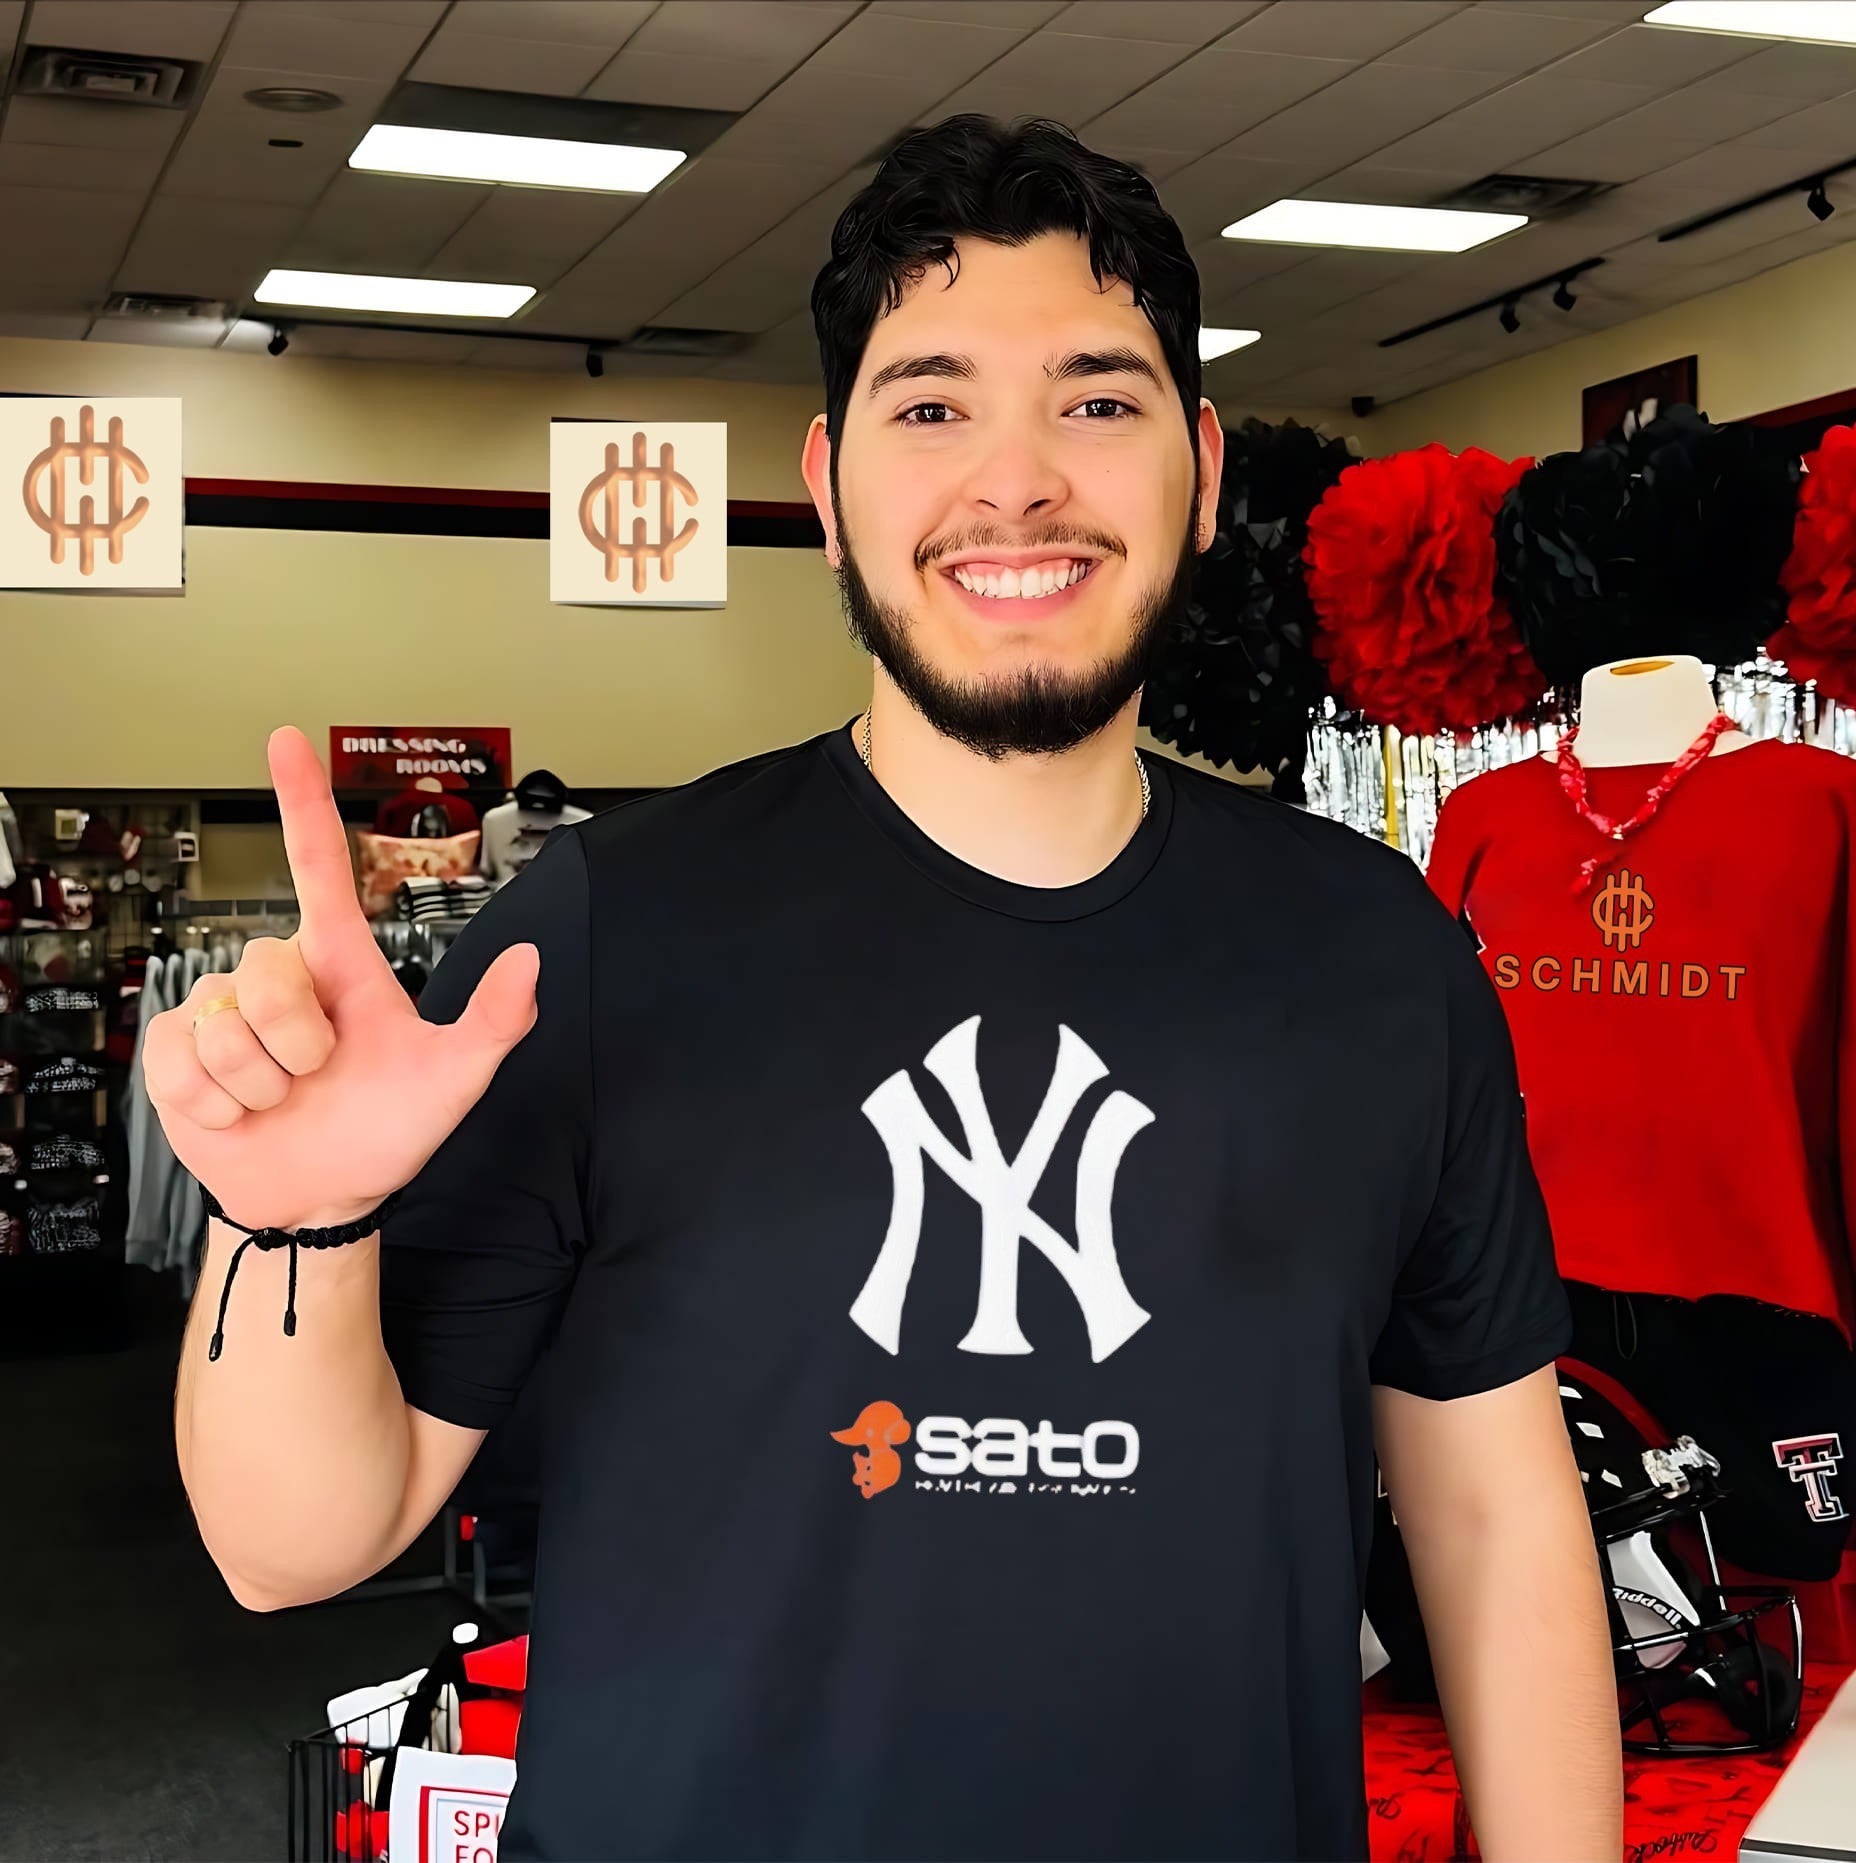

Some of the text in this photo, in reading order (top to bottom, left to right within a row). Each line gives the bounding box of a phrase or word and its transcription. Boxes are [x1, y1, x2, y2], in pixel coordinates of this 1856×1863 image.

[342, 737, 467, 754] DRESSING
[396, 758, 487, 775] ROOMS
[1494, 953, 1746, 1001] SCHMIDT
[848, 1014, 1156, 1364] NY
